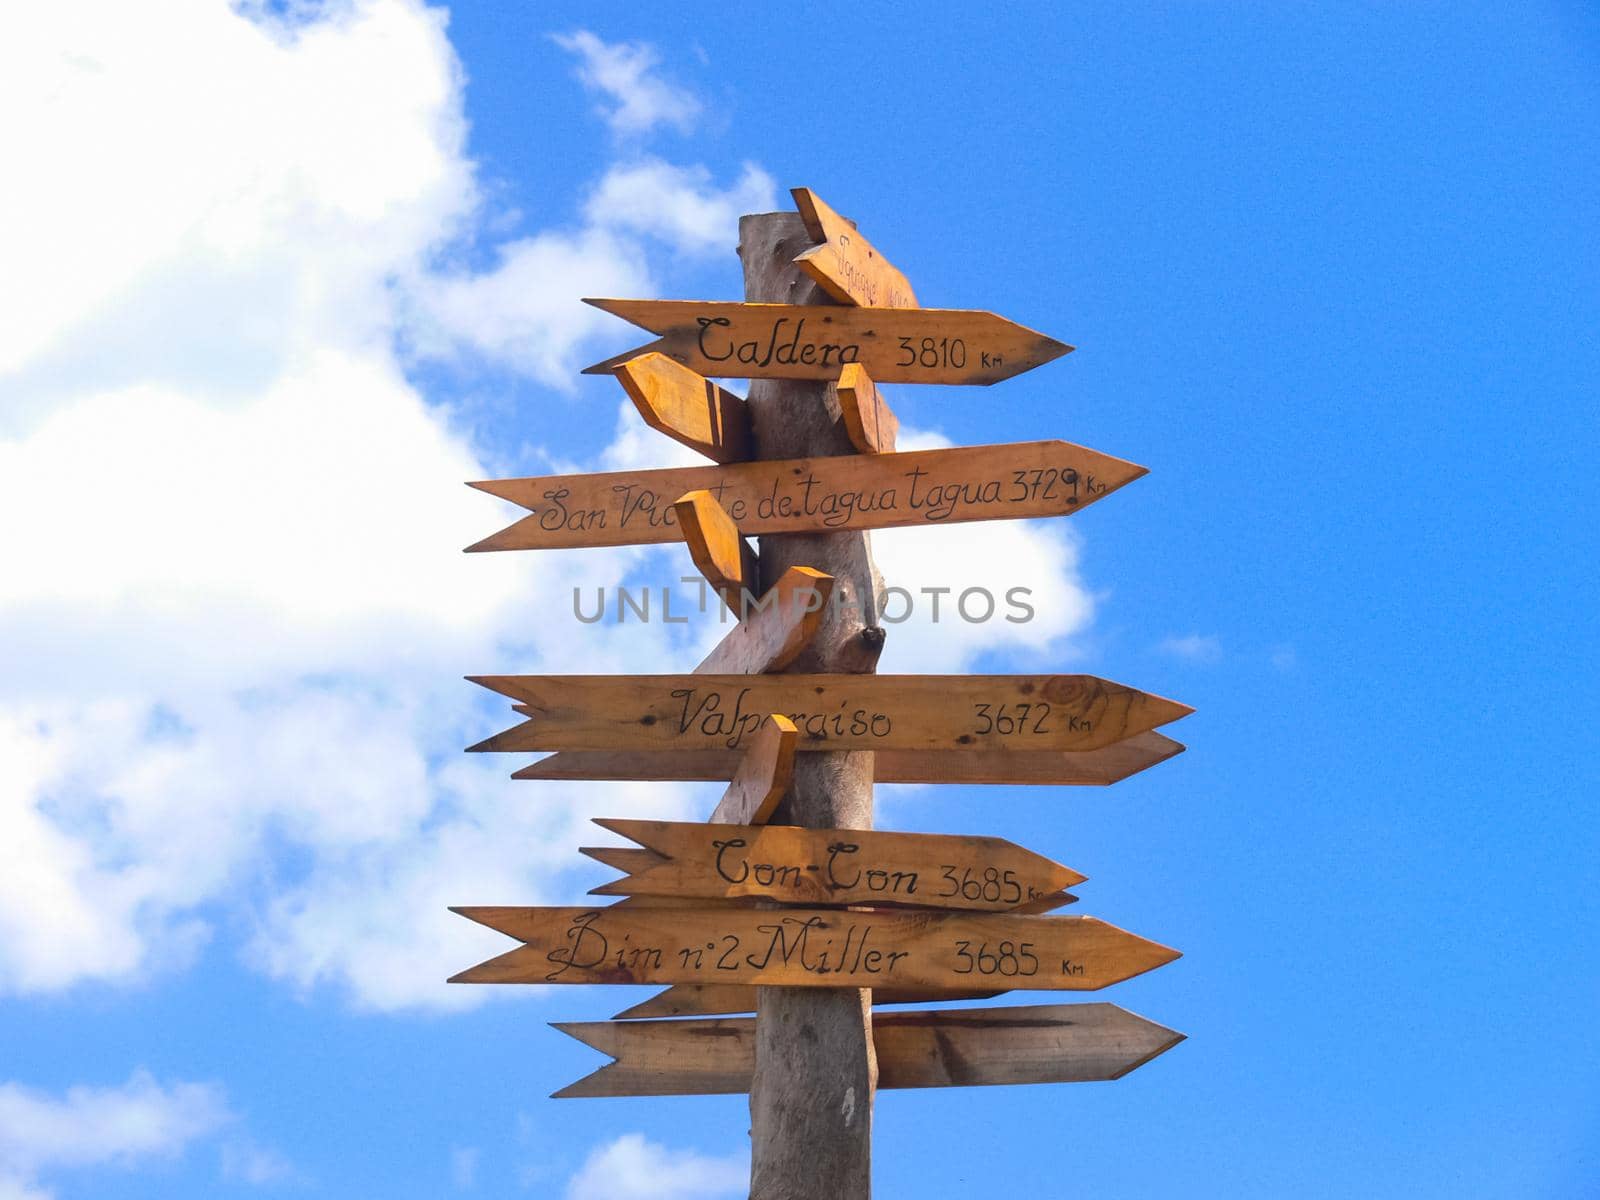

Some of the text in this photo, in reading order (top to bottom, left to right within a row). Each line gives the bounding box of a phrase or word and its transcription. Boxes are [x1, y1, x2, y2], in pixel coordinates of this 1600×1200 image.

[697, 317, 860, 367] Caldera
[896, 337, 966, 369] 3810
[540, 488, 607, 531] San
[612, 479, 748, 529] Victe
[757, 477, 793, 519] de
[797, 474, 897, 527] tagua
[904, 465, 1001, 520] tagua
[1009, 468, 1079, 502] 3729
[671, 688, 892, 748] Valpraiso
[974, 702, 1051, 736] 3672
[938, 864, 1021, 904] 3685
[545, 912, 662, 981] Dim
[746, 916, 910, 974] Miller
[953, 940, 1039, 977] 3685
